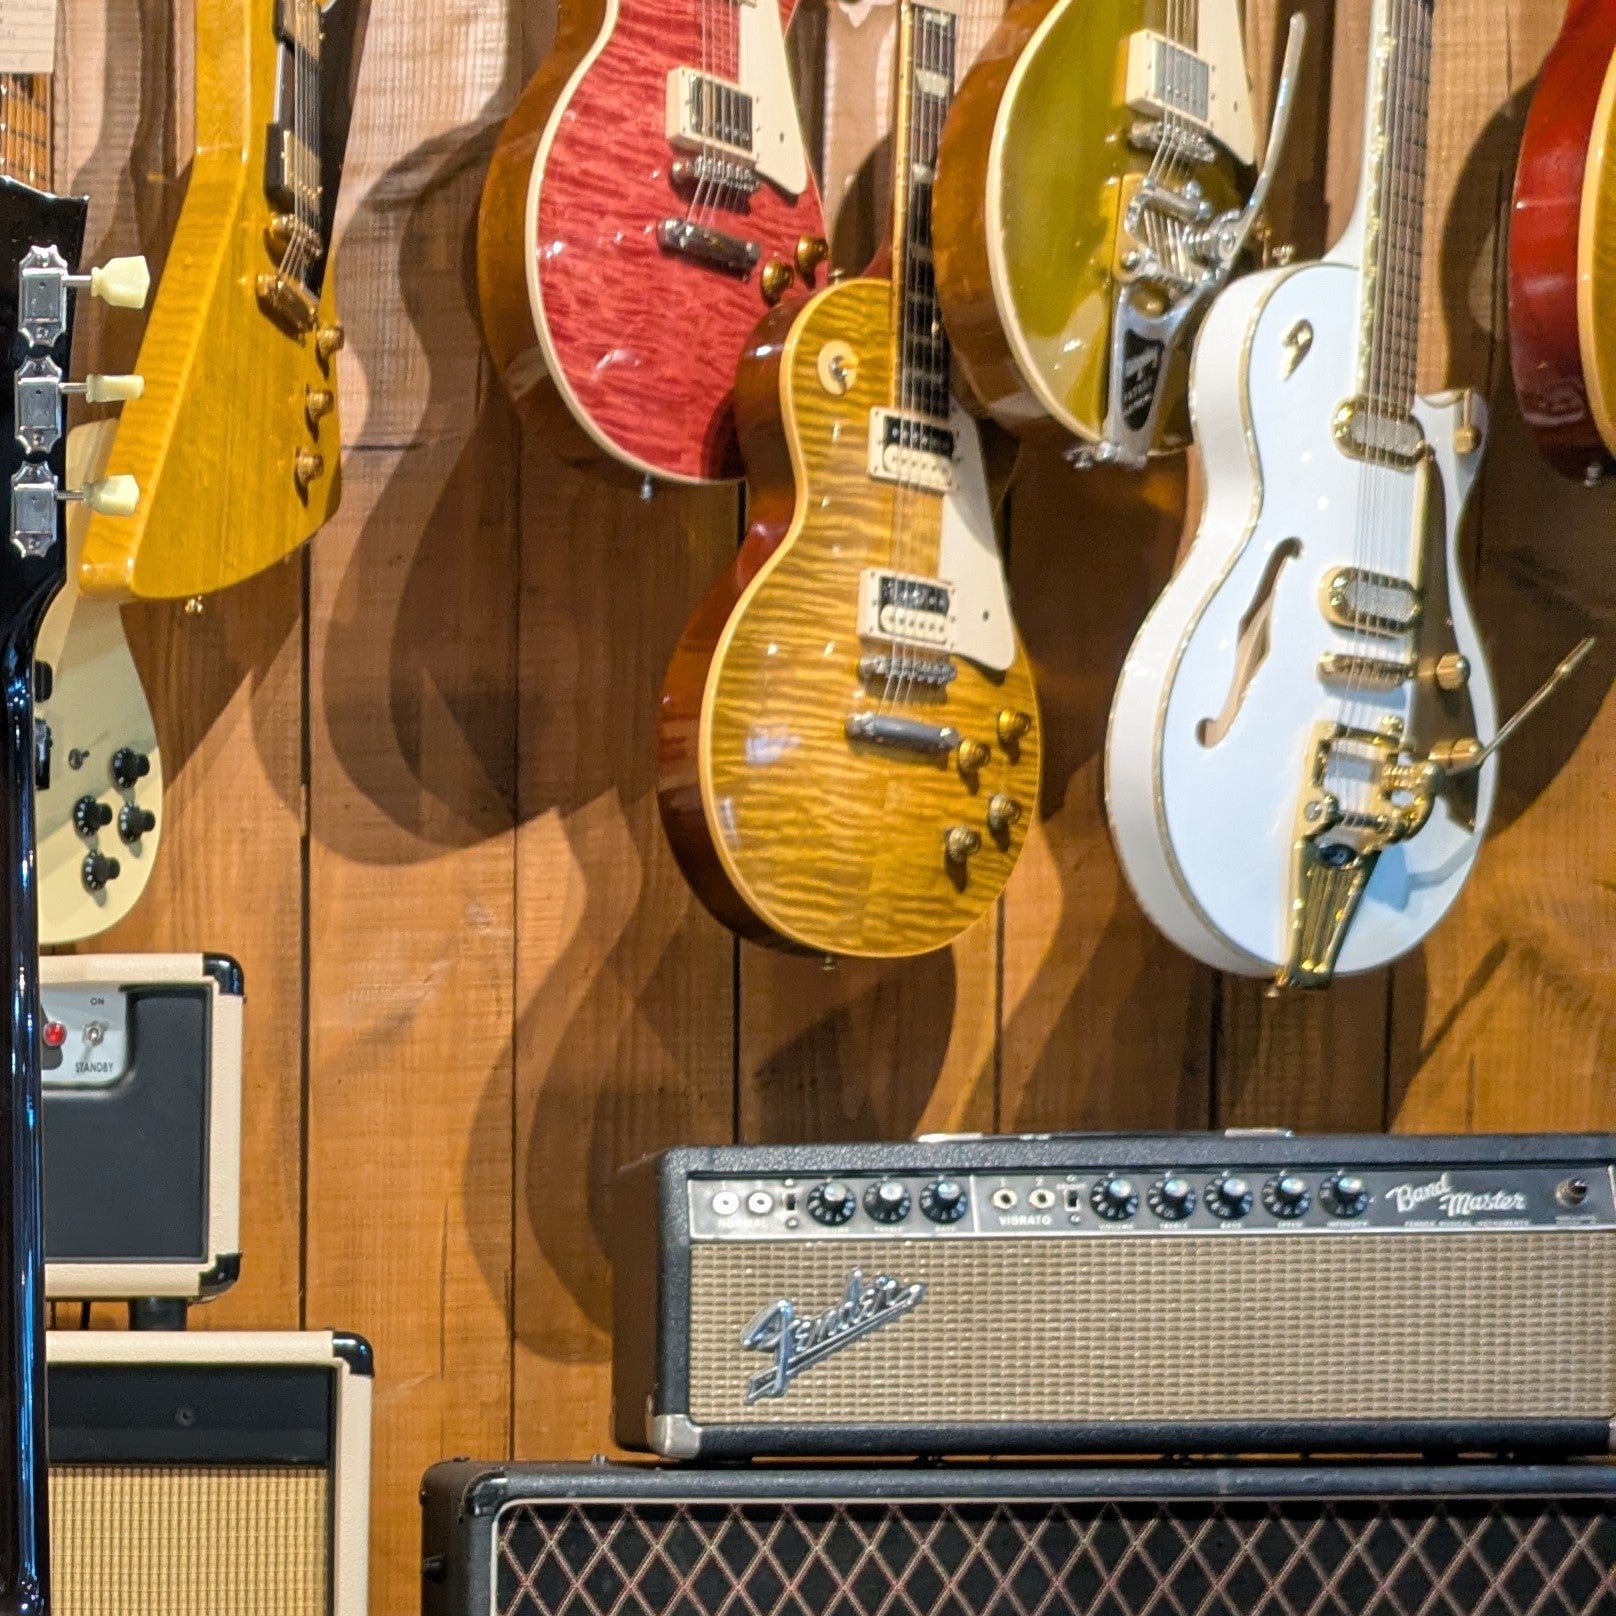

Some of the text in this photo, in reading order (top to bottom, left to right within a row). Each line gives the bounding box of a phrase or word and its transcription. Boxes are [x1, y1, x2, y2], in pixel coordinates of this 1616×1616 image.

[90, 997, 104, 1005] ON
[74, 1062, 114, 1073] STANDBY
[1385, 1172, 1527, 1218] Band Master
[999, 1215, 1052, 1226] VIBRATO
[740, 1267, 927, 1406] Fender
